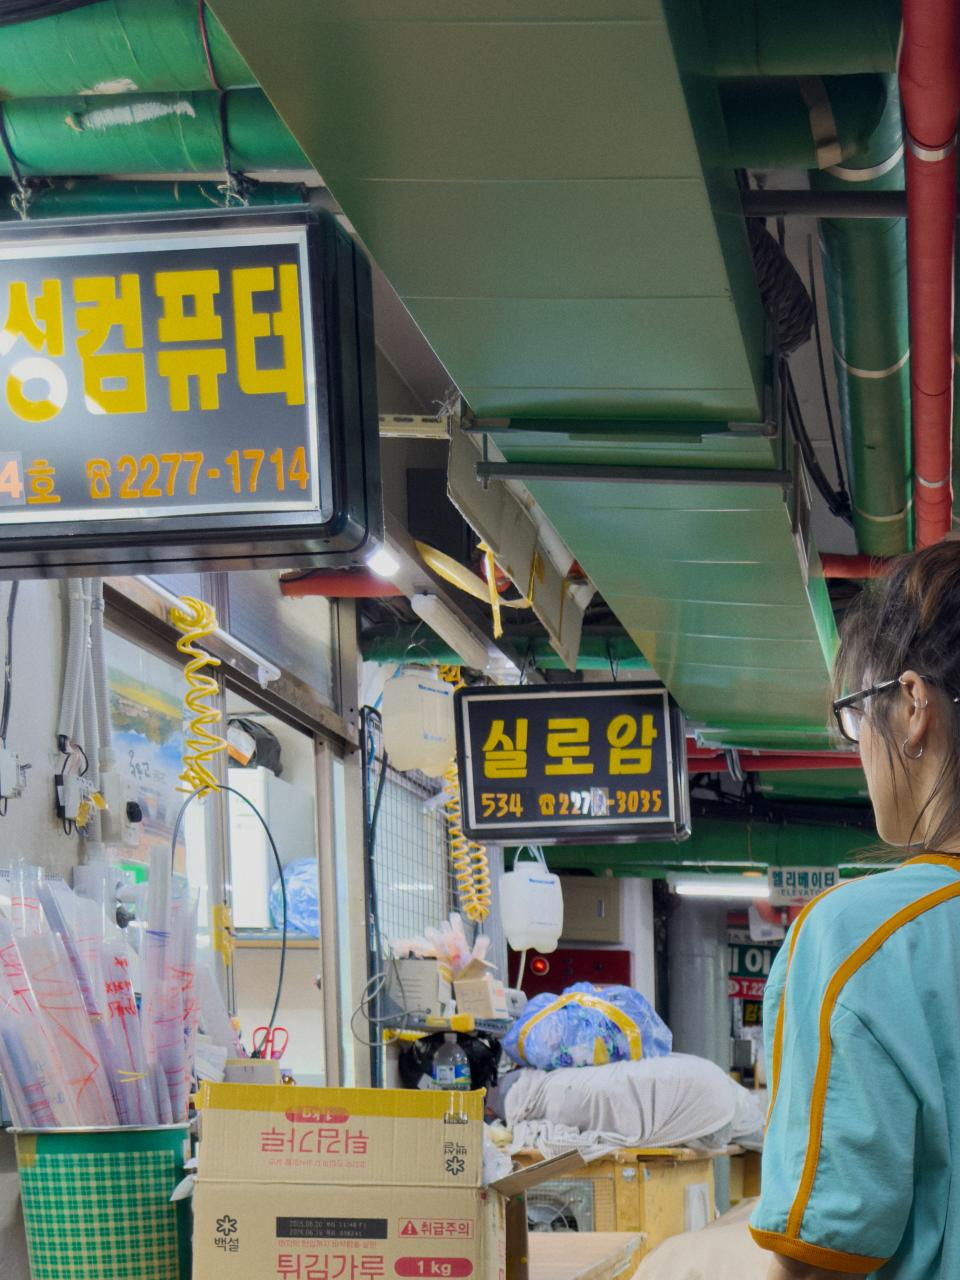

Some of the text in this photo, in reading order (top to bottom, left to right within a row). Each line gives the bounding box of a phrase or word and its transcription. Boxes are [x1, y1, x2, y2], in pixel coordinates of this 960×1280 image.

[0, 263, 305, 423] 성컴퓨터
[117, 446, 310, 499] 2277-1714
[482, 713, 658, 779] 실로암
[481, 788, 663, 818] 534 227-3035
[772, 870, 835, 888] 엘리베이터
[261, 1126, 369, 1155] 튀김가루
[420, 1222, 470, 1236] 취급주의
[214, 1237, 240, 1252] 백설
[417, 1259, 452, 1277] 1 kg
